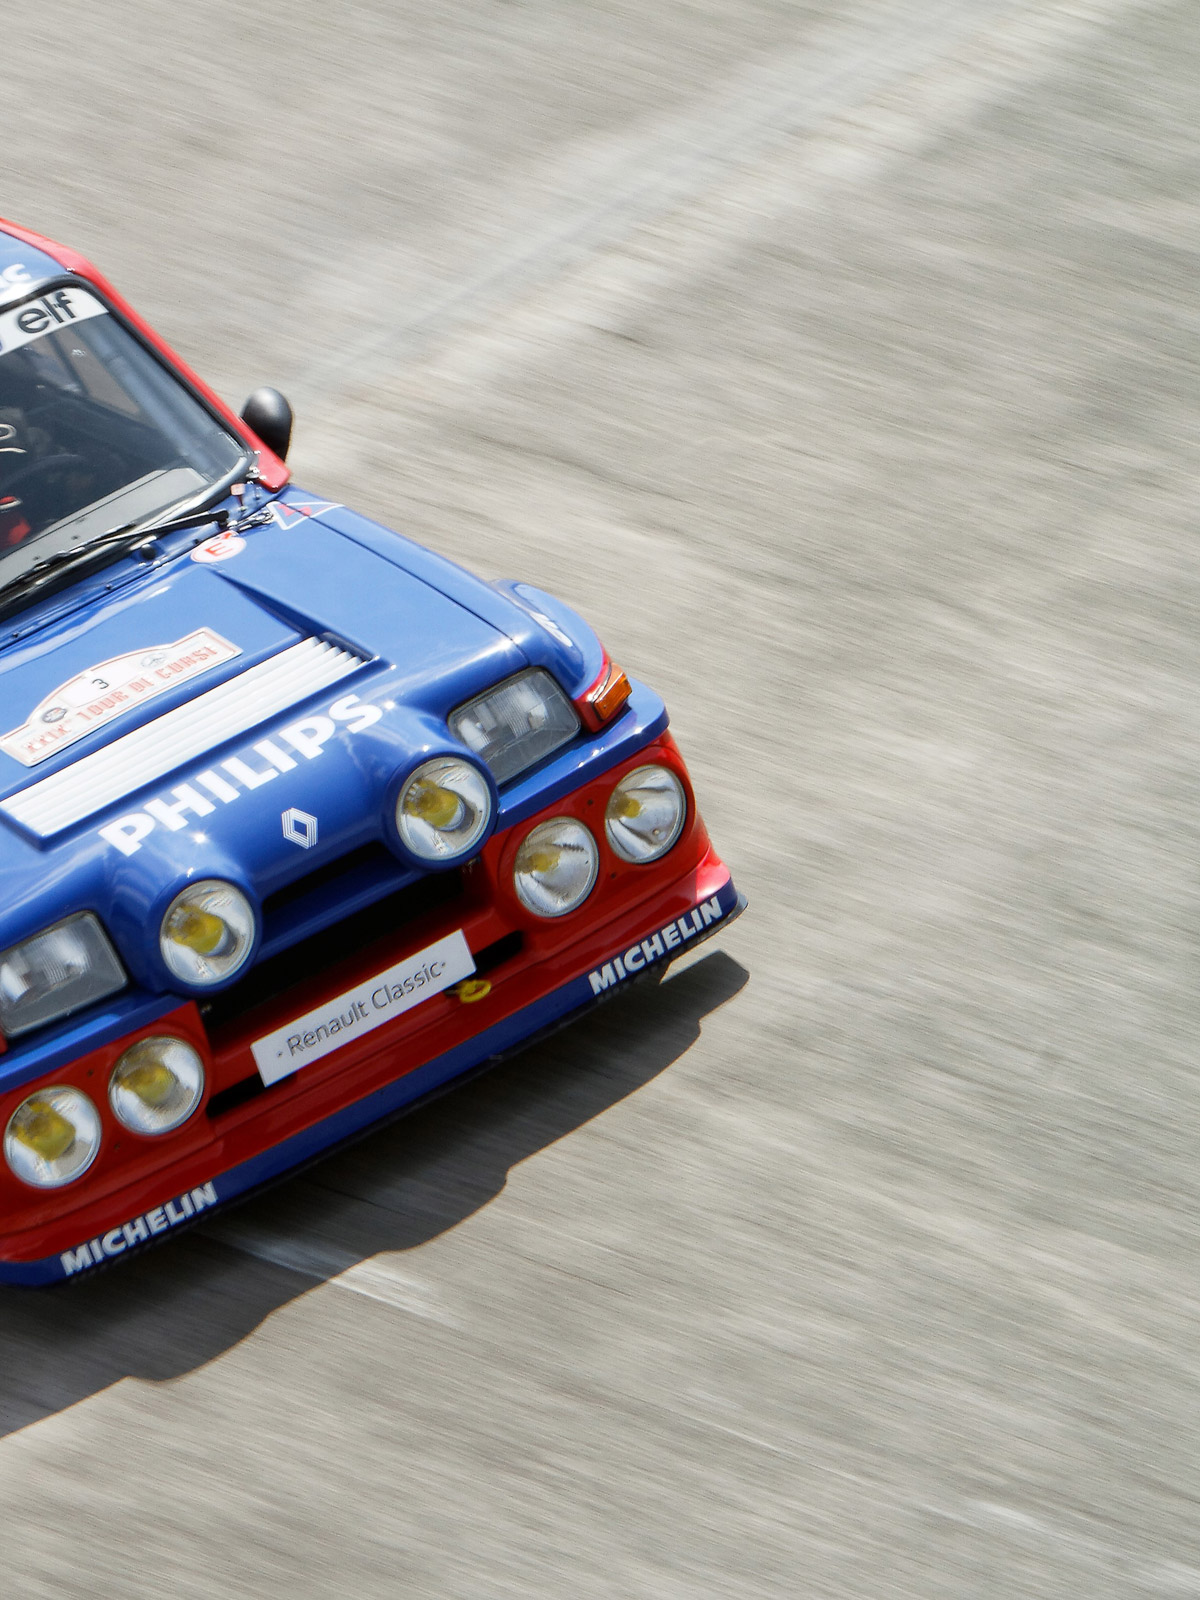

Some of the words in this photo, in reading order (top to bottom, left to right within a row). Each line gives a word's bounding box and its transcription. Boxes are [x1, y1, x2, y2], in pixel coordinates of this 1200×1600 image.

[15, 290, 81, 336] elf
[91, 677, 109, 690] 3
[97, 692, 386, 857] PHILIPS
[591, 894, 725, 997] MICHELIN
[286, 1000, 370, 1057] Renault
[370, 961, 443, 1011] Classic
[59, 1180, 221, 1278] MICHELIN
